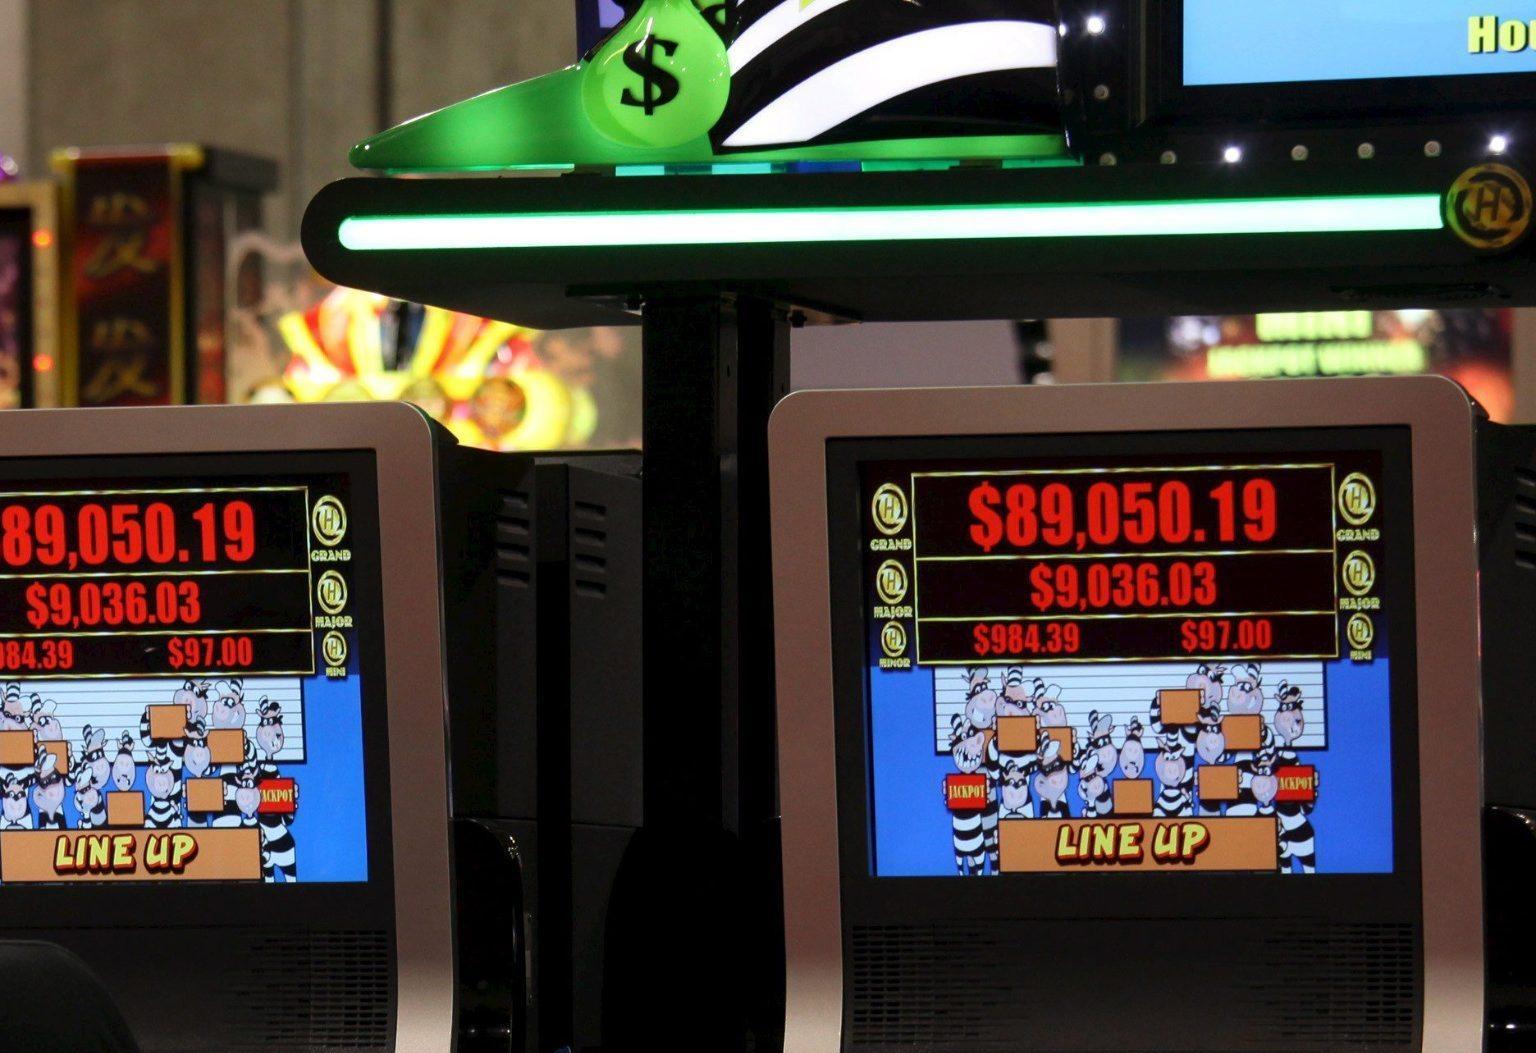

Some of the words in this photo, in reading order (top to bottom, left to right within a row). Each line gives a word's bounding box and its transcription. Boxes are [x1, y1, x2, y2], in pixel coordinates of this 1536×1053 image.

[1468, 15, 1536, 53] Ho
[969, 478, 1277, 553] $89,050.19
[1336, 529, 1380, 541] GRAND
[870, 539, 912, 551] GRAND
[311, 550, 351, 562] GRAND
[1030, 562, 1217, 611] $9,036.03
[26, 581, 201, 629] $9,036.03
[1340, 598, 1380, 610] MAJOR
[874, 606, 913, 619] MAJOR
[315, 616, 353, 629] MAJOR
[974, 623, 1081, 656] $984.39
[1182, 619, 1272, 652] $97.00
[168, 636, 252, 668] $97.00
[1350, 650, 1372, 660] MINI
[879, 658, 910, 668] MINOR
[325, 667, 346, 678] MINI
[1277, 776, 1313, 791] ACKPOT
[259, 789, 293, 803] ACKPOT
[948, 783, 985, 801] JACKPOT
[1057, 823, 1141, 863] LINE
[1153, 822, 1208, 861] UP
[54, 834, 132, 874] LINE
[145, 833, 198, 872] UP
